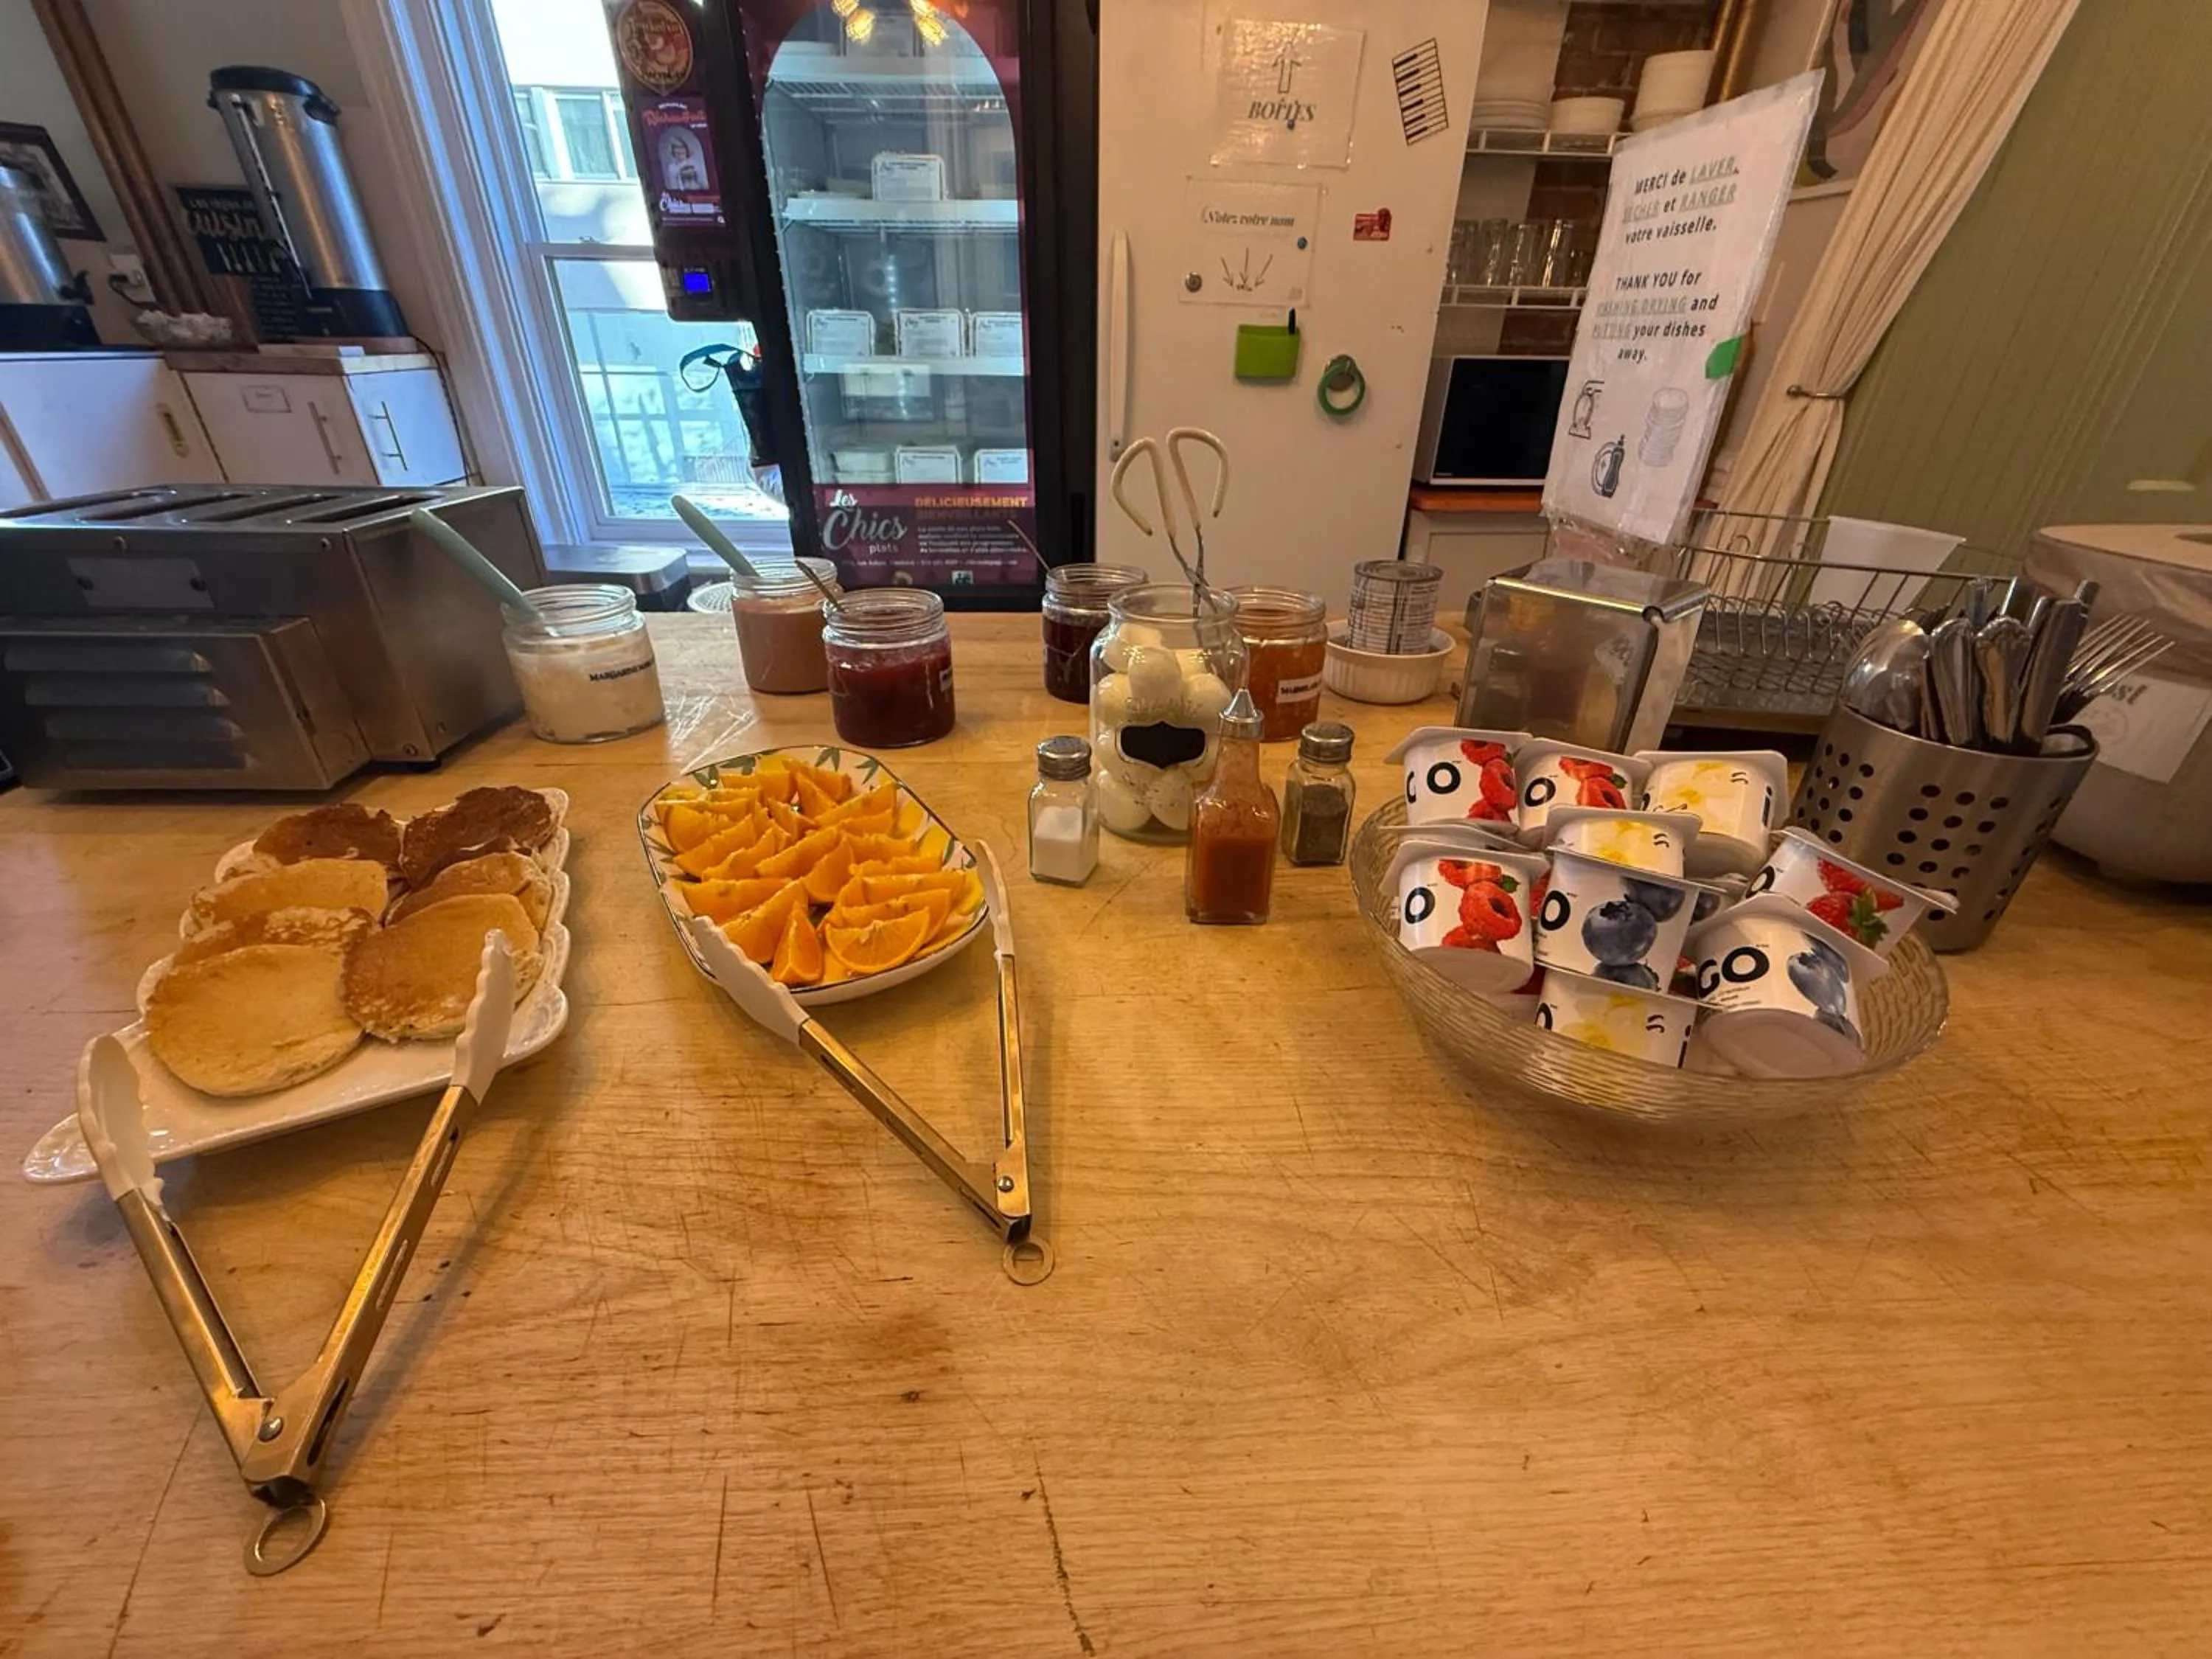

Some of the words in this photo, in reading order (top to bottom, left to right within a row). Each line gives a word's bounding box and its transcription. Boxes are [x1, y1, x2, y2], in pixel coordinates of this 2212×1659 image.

[1634, 173, 1668, 195] MERCI
[1671, 169, 1686, 187] de
[1663, 197, 1676, 213] et
[1679, 184, 1737, 213] RANGER
[1626, 228, 1652, 245] votre
[1656, 216, 1717, 238] vaisselle.
[1615, 274, 1649, 291] THANK
[1652, 271, 1678, 288] YOU
[1681, 269, 1702, 286] for
[1691, 293, 1719, 311] and
[1632, 324, 1660, 341] your
[1663, 321, 1707, 337] dishes
[1618, 347, 1646, 364] away.
[830, 489, 858, 507] Les
[822, 507, 908, 550] Chics
[869, 542, 899, 555] plats
